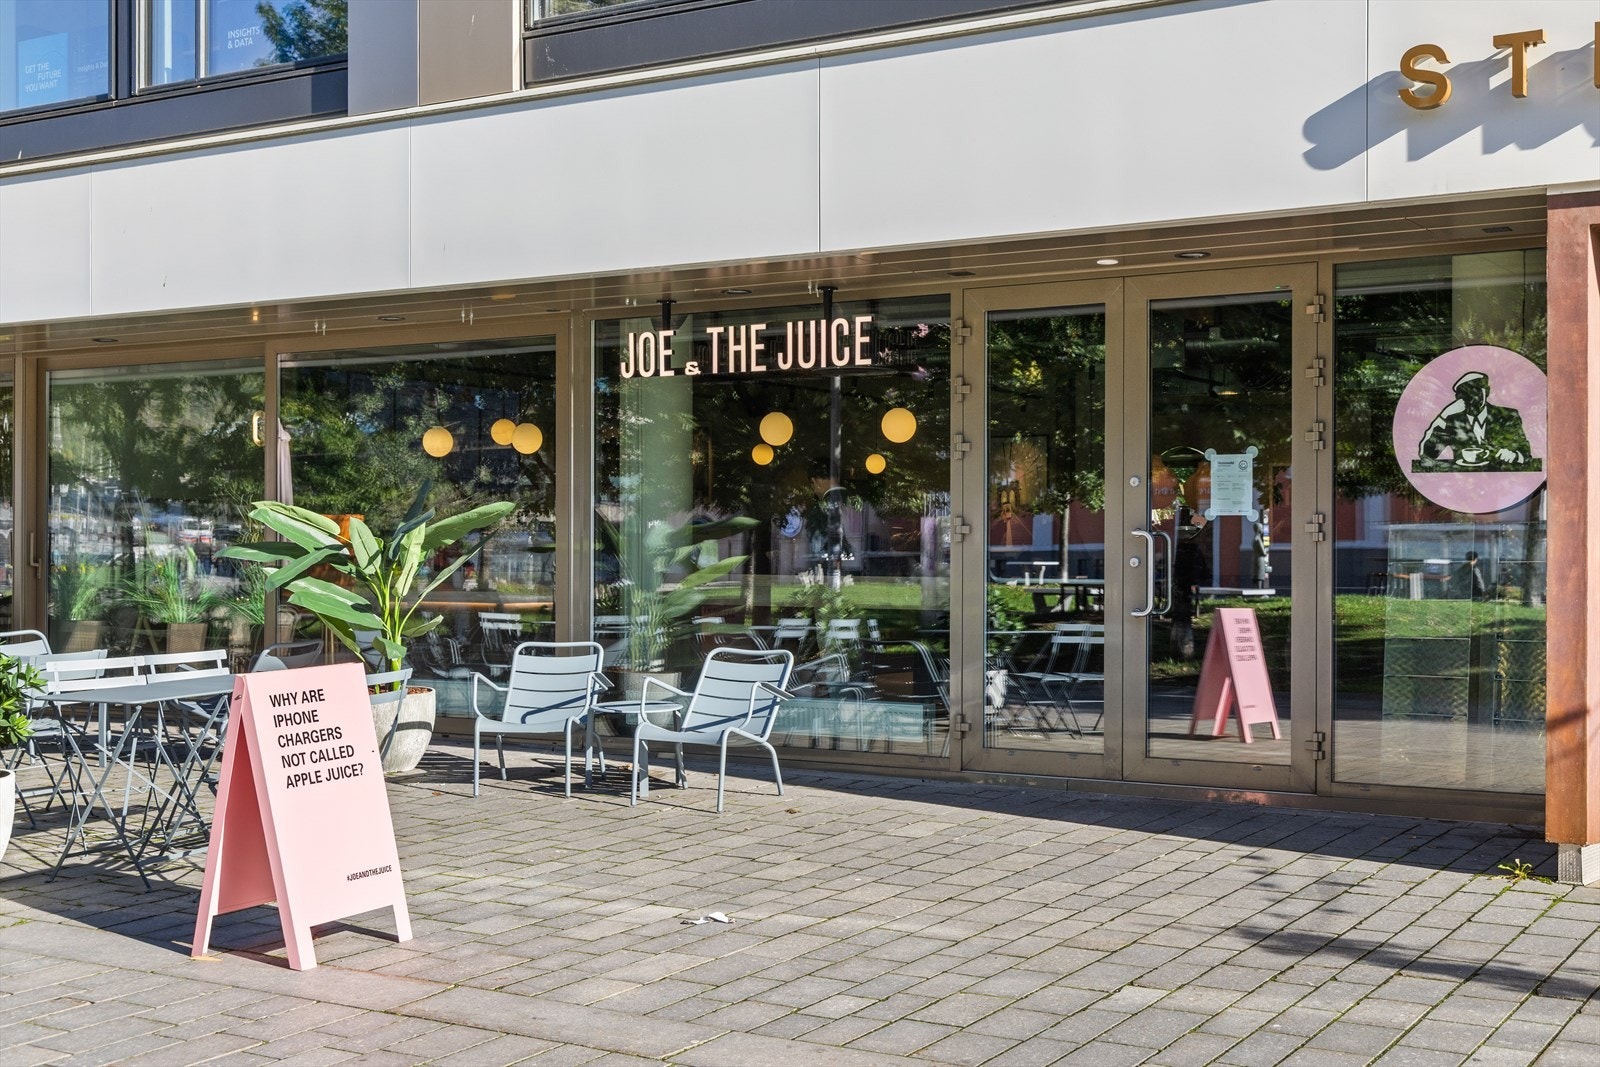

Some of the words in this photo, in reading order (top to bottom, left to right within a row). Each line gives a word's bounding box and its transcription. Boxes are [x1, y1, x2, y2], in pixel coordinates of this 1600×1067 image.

[227, 25, 261, 39] INSIGHTS
[227, 40, 234, 49] &
[234, 37, 254, 48] DATA
[25, 64, 37, 74] GET
[37, 62, 50, 72] THE
[37, 69, 62, 81] FUTURE
[1398, 21, 1600, 110] ST
[24, 82, 38, 93] YOU
[39, 80, 58, 91] WANT
[620, 330, 676, 379] JOE
[685, 360, 701, 376] &
[706, 322, 768, 374] THE
[777, 315, 873, 370] JUICE
[269, 692, 298, 708] WHY
[301, 688, 326, 704] ARE
[273, 709, 320, 728] IPHONE
[277, 726, 343, 748] CHARGERS
[281, 752, 306, 769] NOT
[309, 744, 355, 764] CALLED
[286, 769, 323, 789] APPLE
[325, 762, 364, 782] JUICE?
